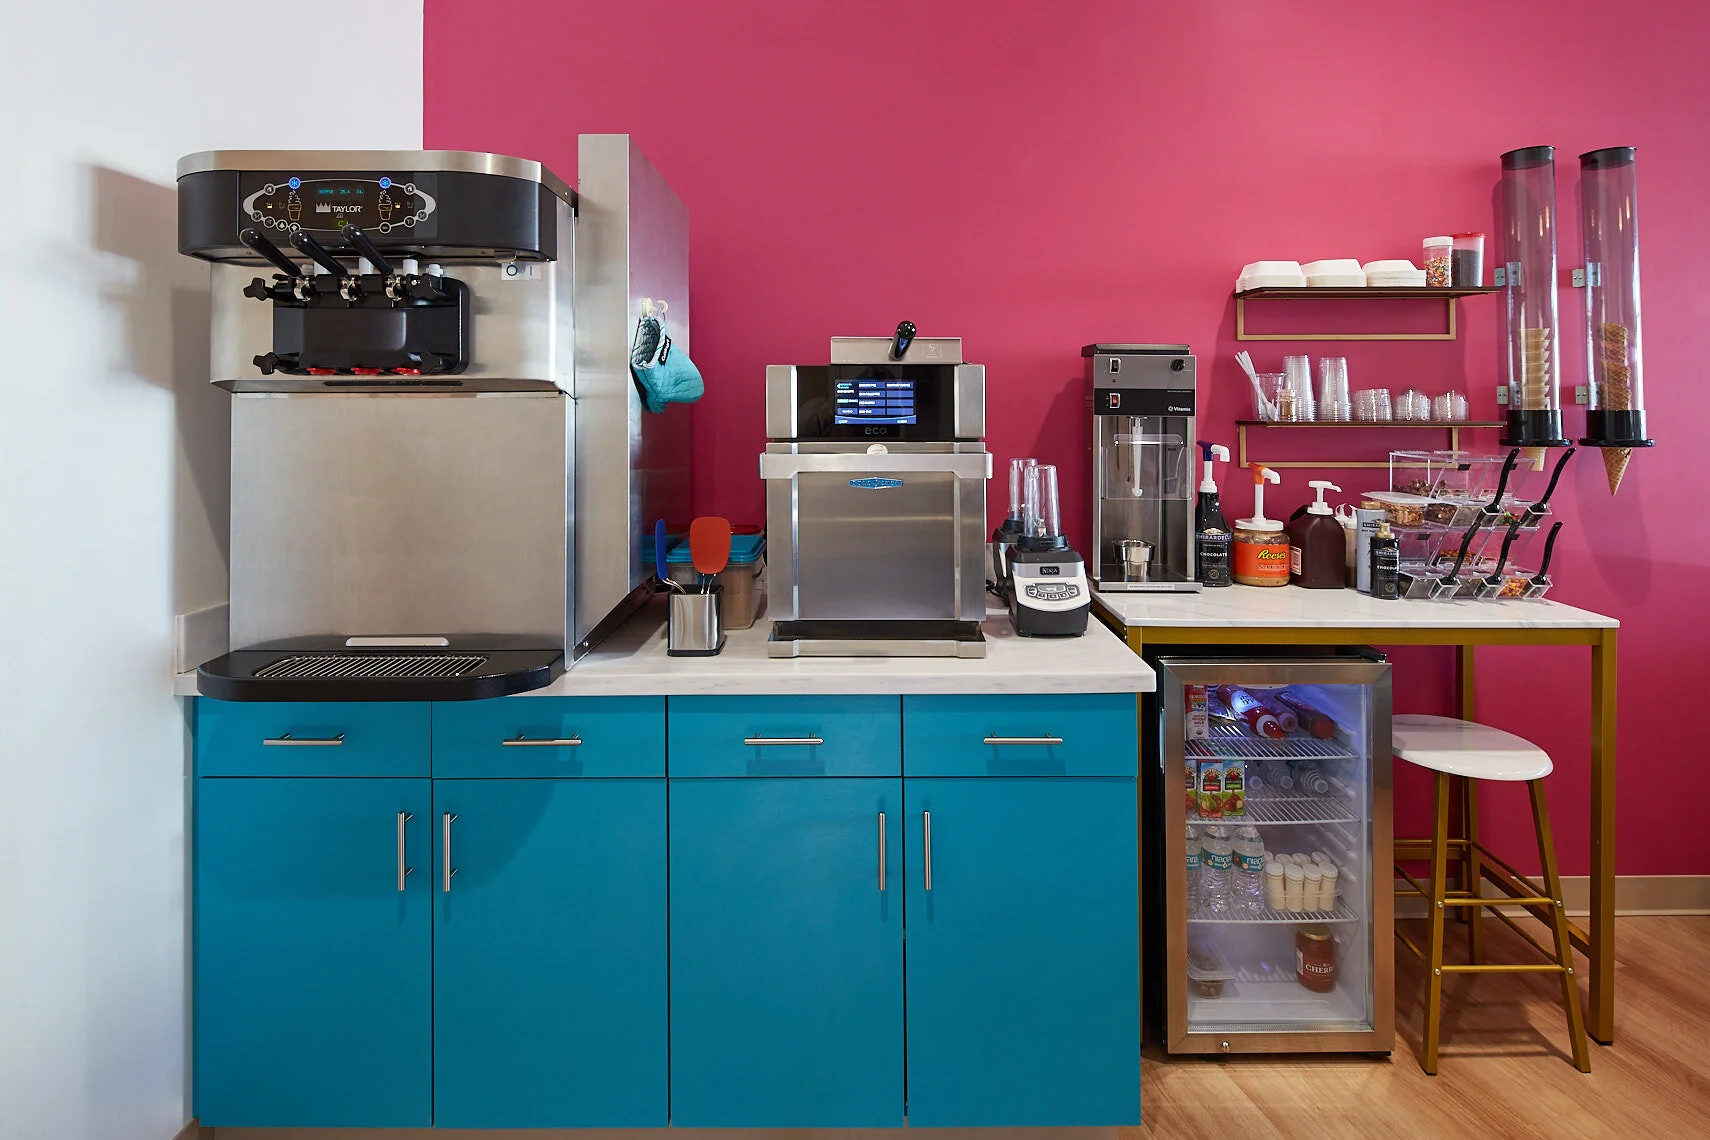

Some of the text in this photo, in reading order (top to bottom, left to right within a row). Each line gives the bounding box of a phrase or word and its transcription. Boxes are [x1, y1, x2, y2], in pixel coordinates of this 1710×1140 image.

[332, 205, 362, 213] TAYLOR
[864, 427, 887, 435] eco
[1257, 549, 1286, 560] Reese's
[1305, 963, 1333, 974] CHERR
